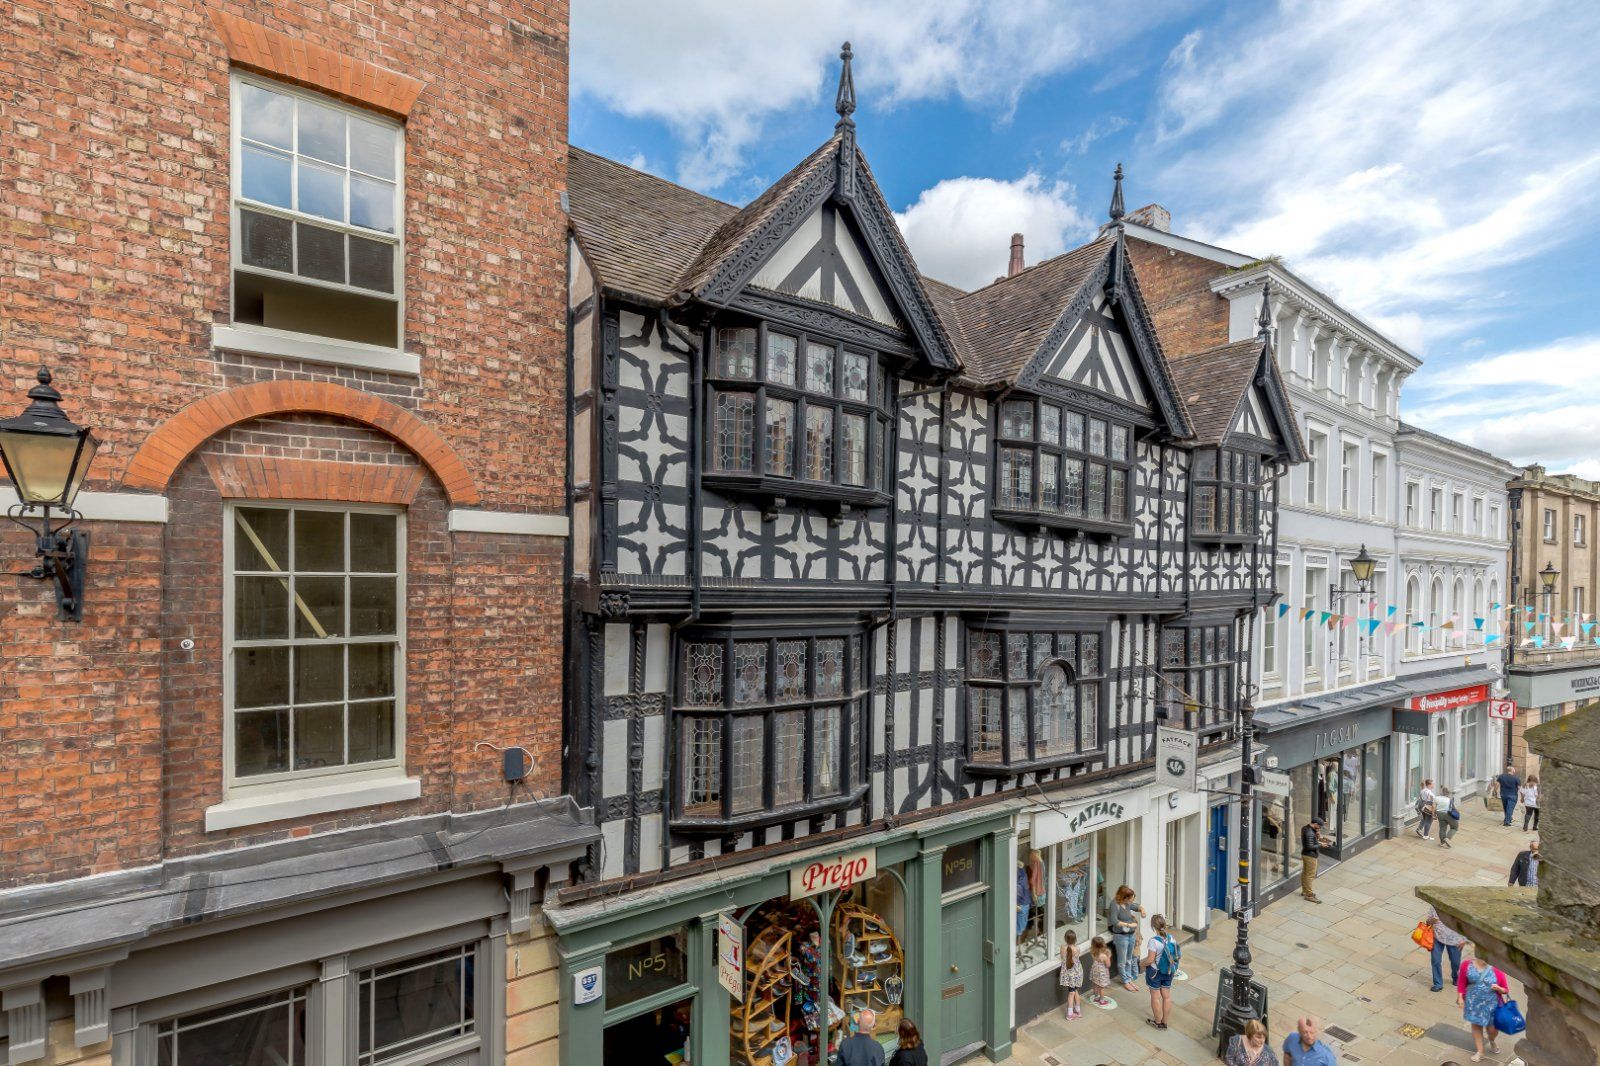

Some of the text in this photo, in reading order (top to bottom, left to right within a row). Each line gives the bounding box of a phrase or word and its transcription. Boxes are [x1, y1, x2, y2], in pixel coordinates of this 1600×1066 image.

[1161, 736, 1192, 748] FATFACE
[1313, 722, 1360, 757] JIGSAW
[1069, 801, 1124, 833] FATFACE
